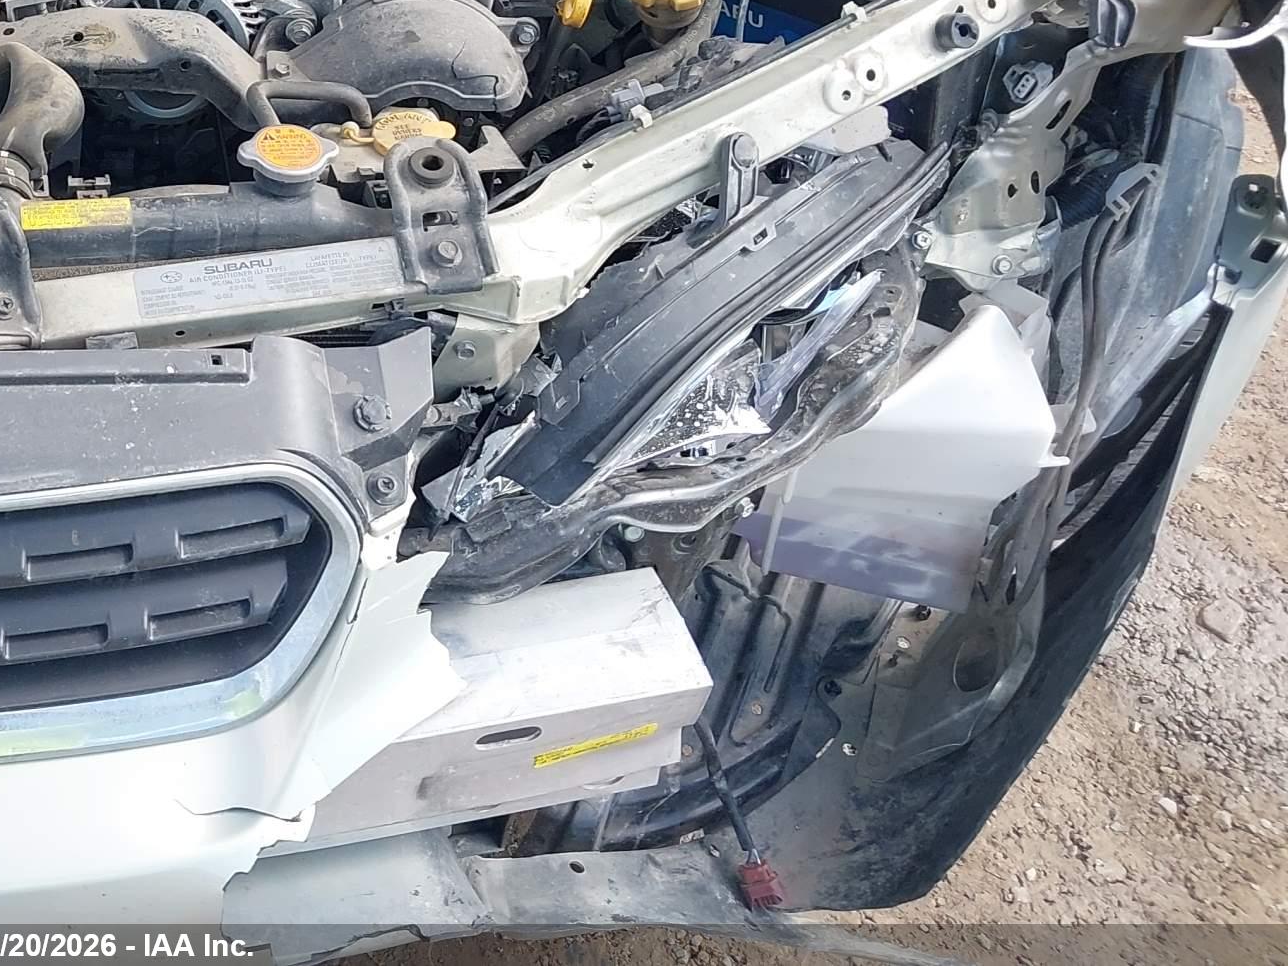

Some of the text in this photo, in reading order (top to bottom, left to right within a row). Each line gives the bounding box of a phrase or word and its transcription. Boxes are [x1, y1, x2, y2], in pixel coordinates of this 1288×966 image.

[203, 258, 273, 275] SUBARU
[189, 275, 202, 283] AIR
[203, 270, 253, 283] CONDITIONER
